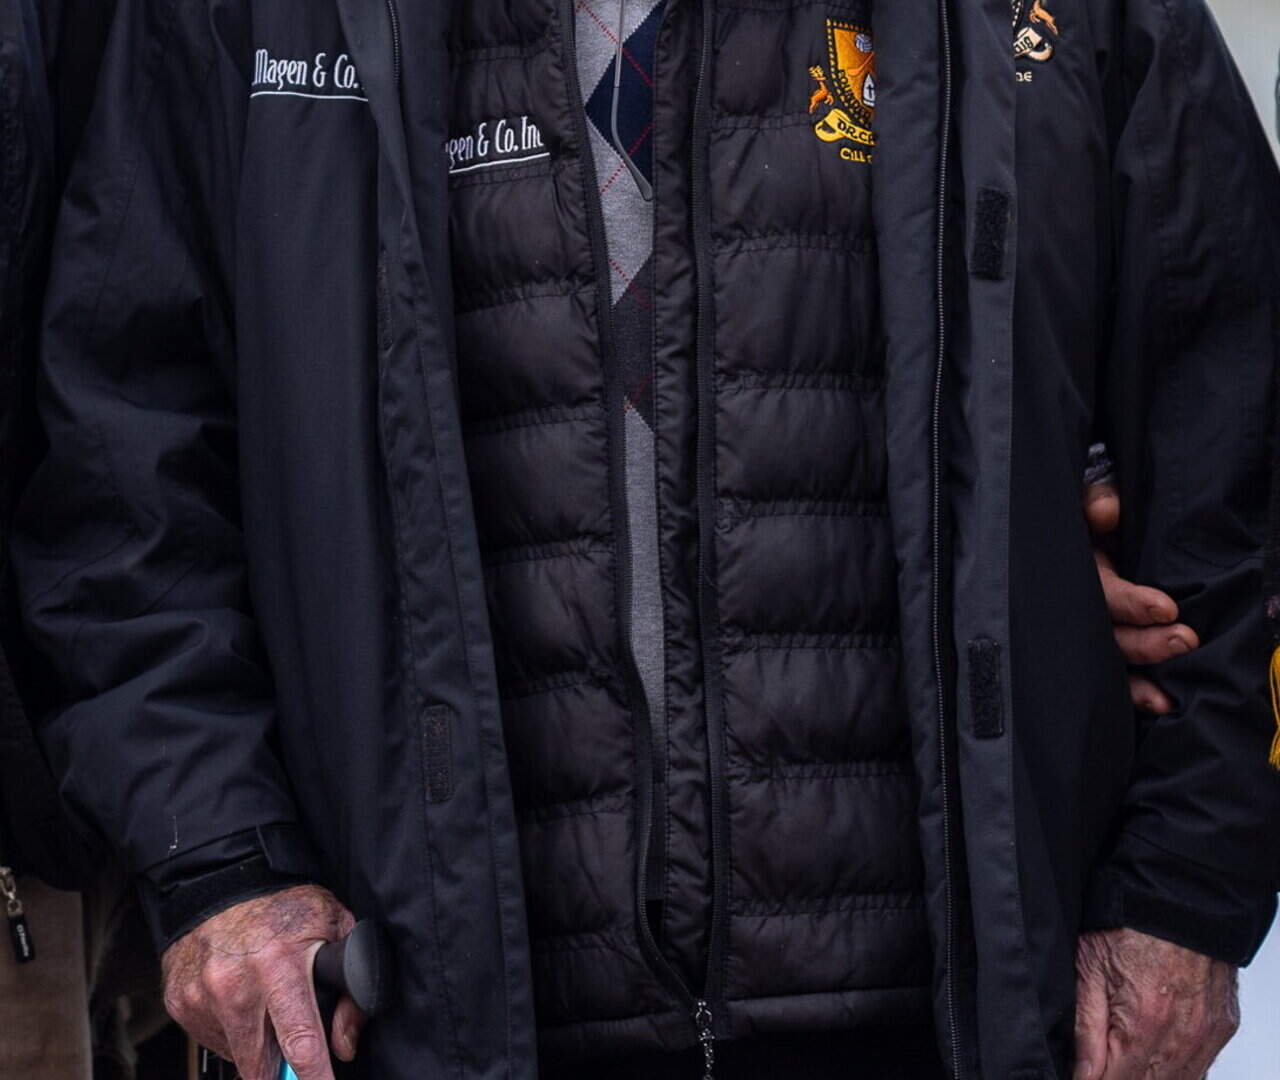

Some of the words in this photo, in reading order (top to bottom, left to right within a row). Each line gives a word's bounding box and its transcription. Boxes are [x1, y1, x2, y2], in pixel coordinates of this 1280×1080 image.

[252, 48, 308, 90] Magen
[312, 52, 327, 88] &
[445, 135, 474, 170] gen
[477, 122, 490, 157] &
[495, 119, 519, 154] Co.
